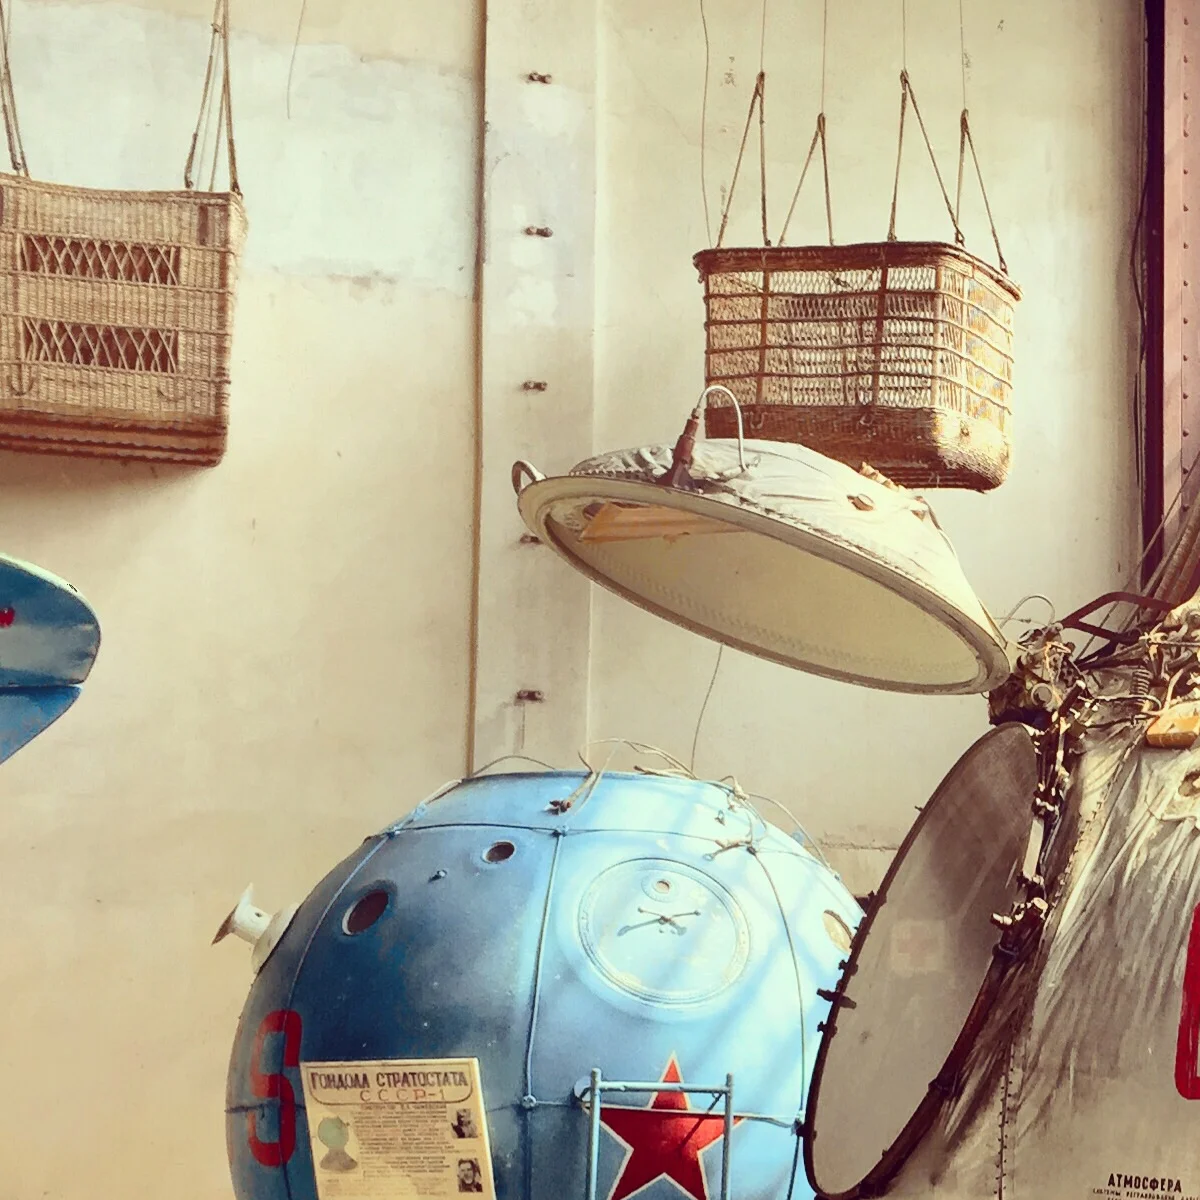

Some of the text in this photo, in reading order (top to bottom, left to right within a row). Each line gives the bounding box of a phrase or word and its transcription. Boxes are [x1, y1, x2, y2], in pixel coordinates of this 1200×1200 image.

[310, 1071, 468, 1091] ГОНДОЛА СТРАТОСТАТА
[360, 1088, 445, 1102] СССР-1
[1107, 1173, 1182, 1193] АТМОСФЕРА
